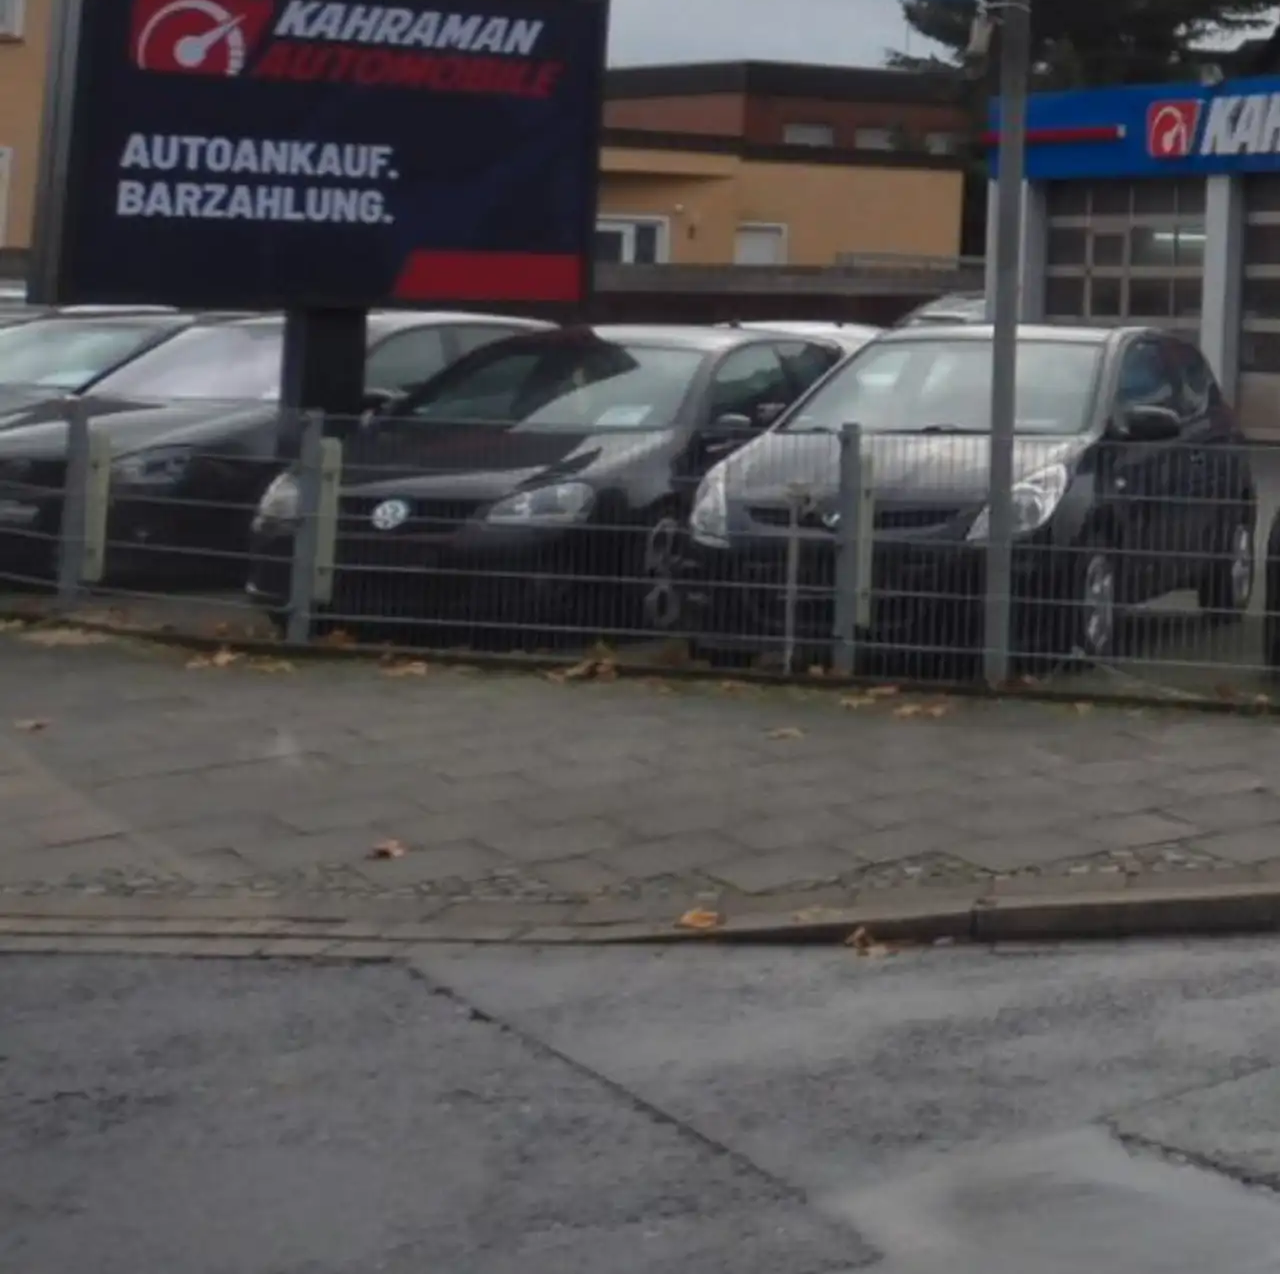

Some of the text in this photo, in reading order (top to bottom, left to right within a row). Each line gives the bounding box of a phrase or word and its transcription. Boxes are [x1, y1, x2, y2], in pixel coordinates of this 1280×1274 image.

[273, 0, 543, 55] KAHRAMAN
[254, 45, 564, 99] AUTOMOBILE
[119, 132, 400, 180] AUTOANKAUF.
[116, 180, 394, 224] BARZAHLUNG.
